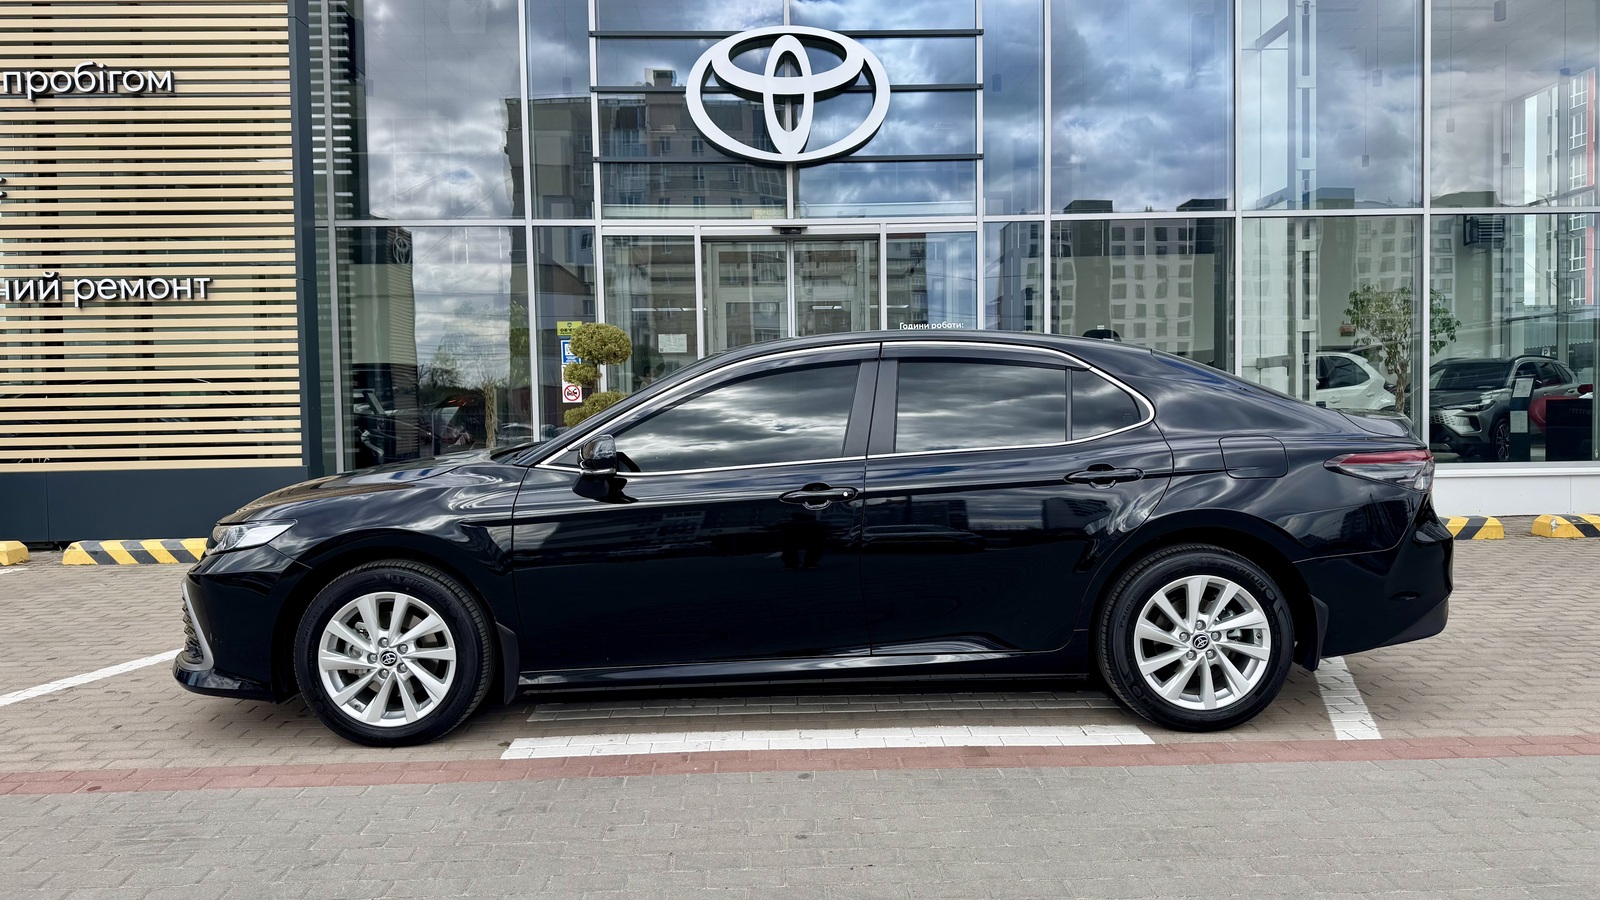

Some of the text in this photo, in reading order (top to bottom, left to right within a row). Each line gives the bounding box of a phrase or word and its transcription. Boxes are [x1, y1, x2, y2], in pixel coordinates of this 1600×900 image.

[2, 61, 175, 101] пробігом
[74, 277, 212, 308] ремонт
[899, 320, 964, 330] Години роботи:
